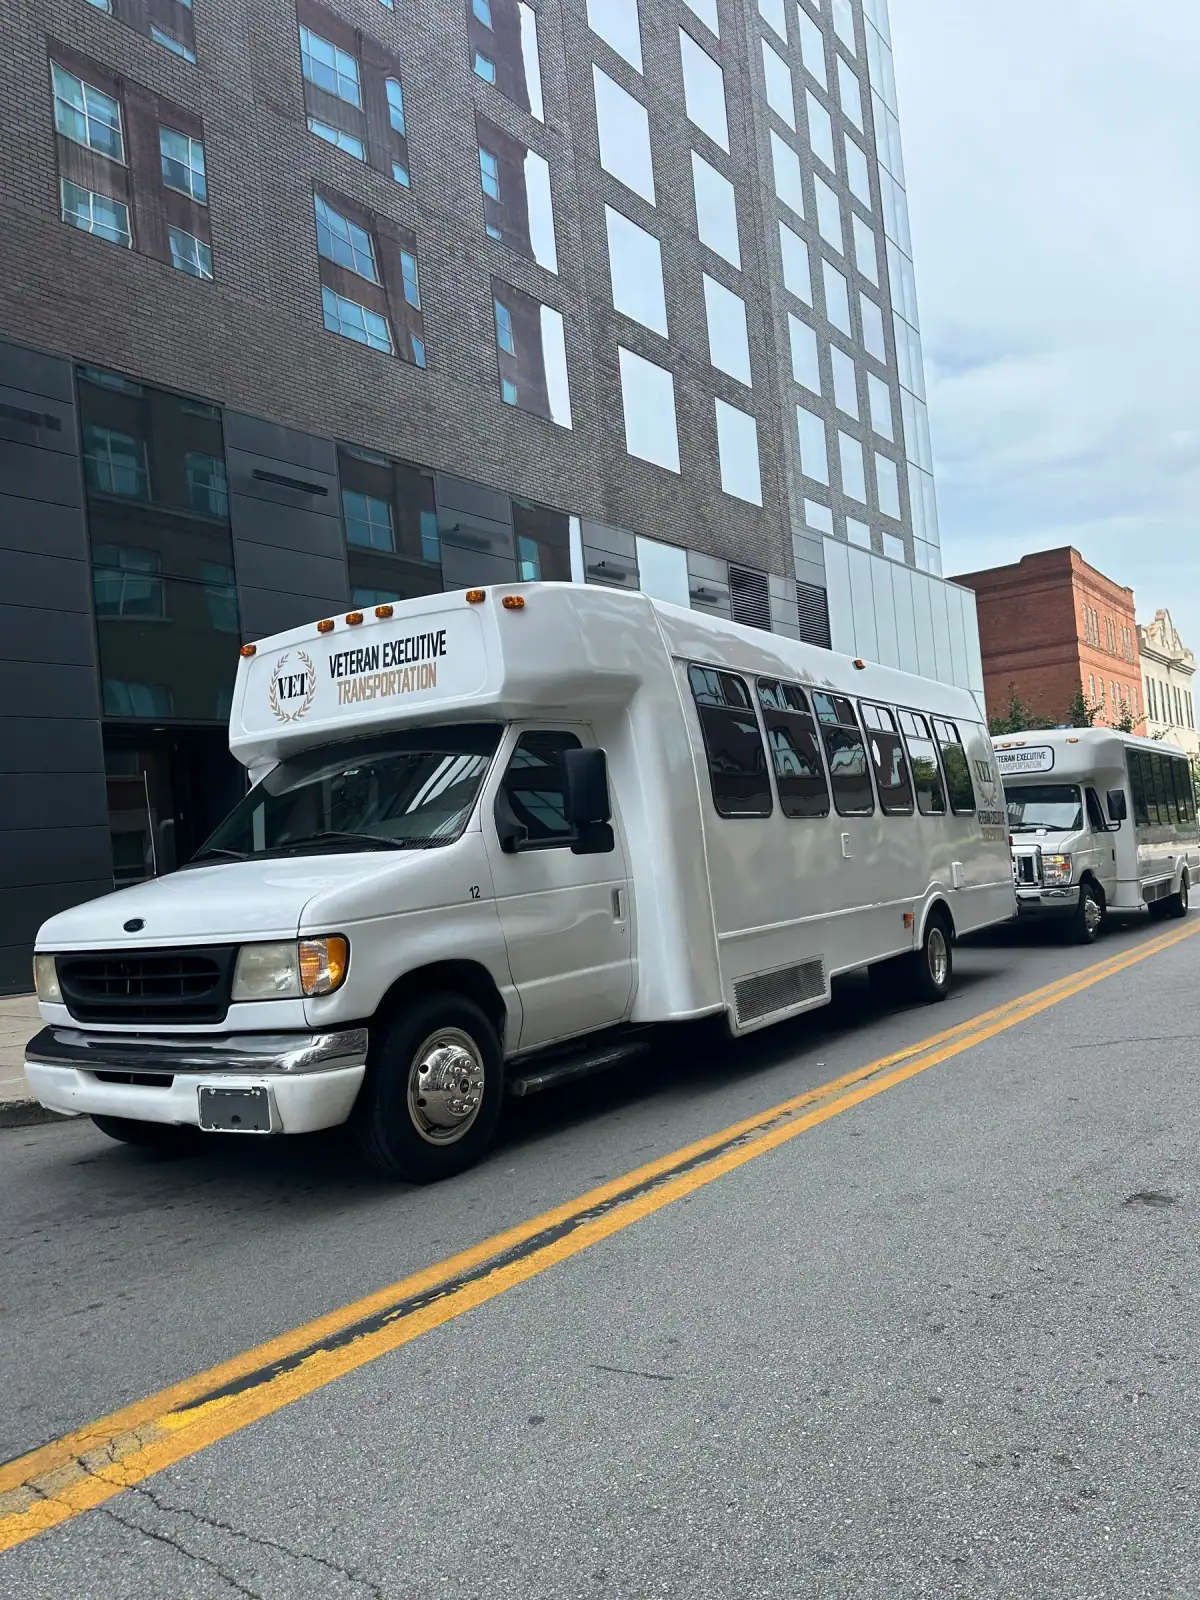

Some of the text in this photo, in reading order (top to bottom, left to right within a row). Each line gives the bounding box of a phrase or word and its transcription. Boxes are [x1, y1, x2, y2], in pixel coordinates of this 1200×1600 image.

[329, 629, 446, 678] VETERAN EXECUTIVE
[337, 662, 436, 705] TRANSPORTATION
[996, 752, 1046, 763] ETERAN EXECUTIVE
[999, 761, 1042, 770] RANSPORTATION
[469, 886, 480, 899] 12
